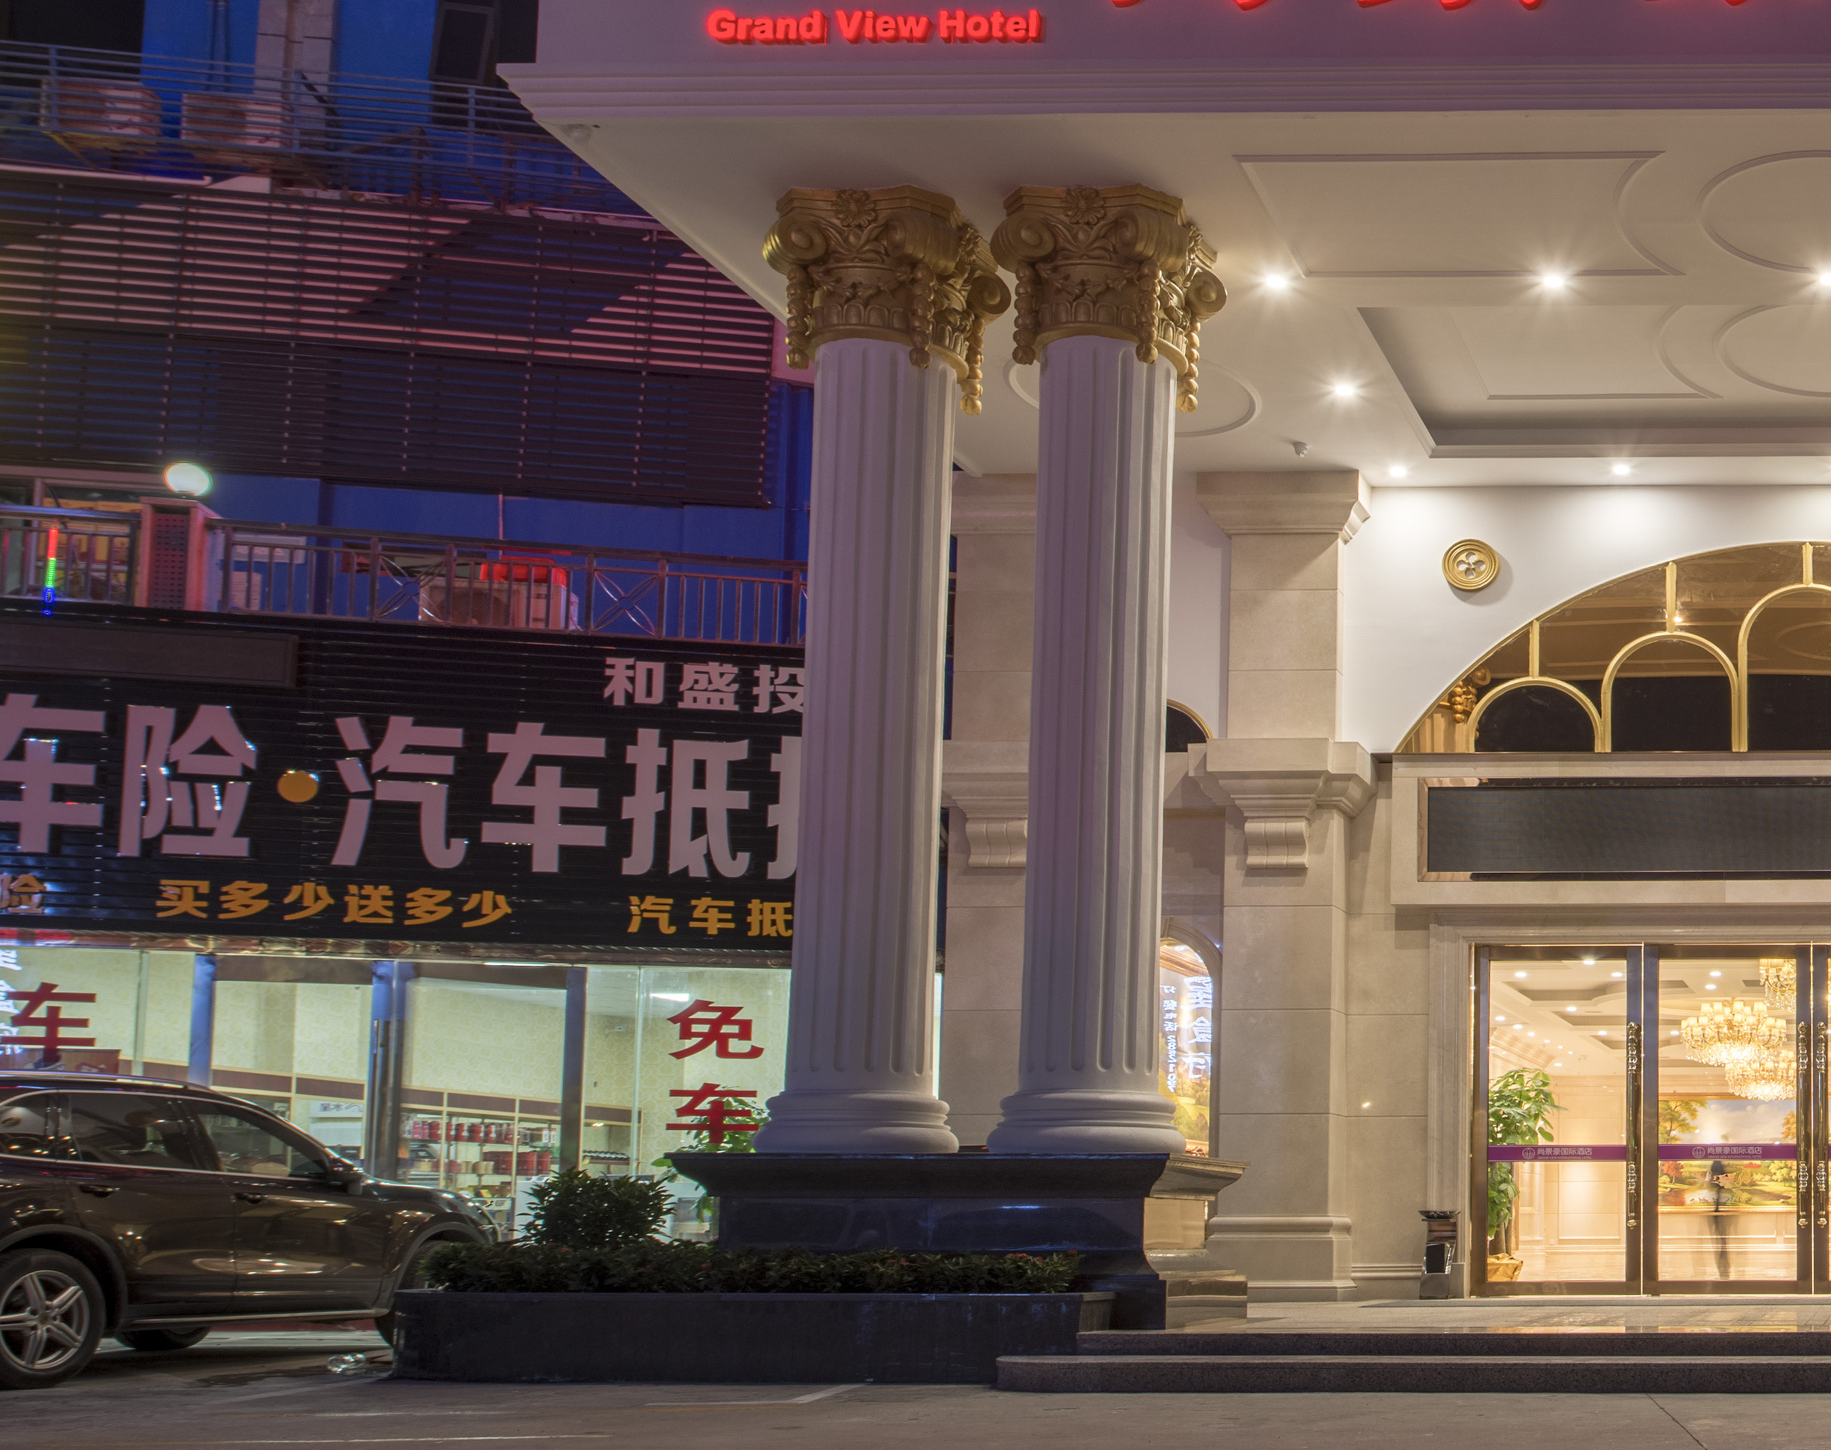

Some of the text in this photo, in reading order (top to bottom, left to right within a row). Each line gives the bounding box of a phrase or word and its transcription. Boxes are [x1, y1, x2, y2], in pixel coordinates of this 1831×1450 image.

[706, 9, 1041, 43] Grand View Hotel
[156, 879, 513, 928] 买多少送多少
[627, 895, 794, 937] 汽车抵
